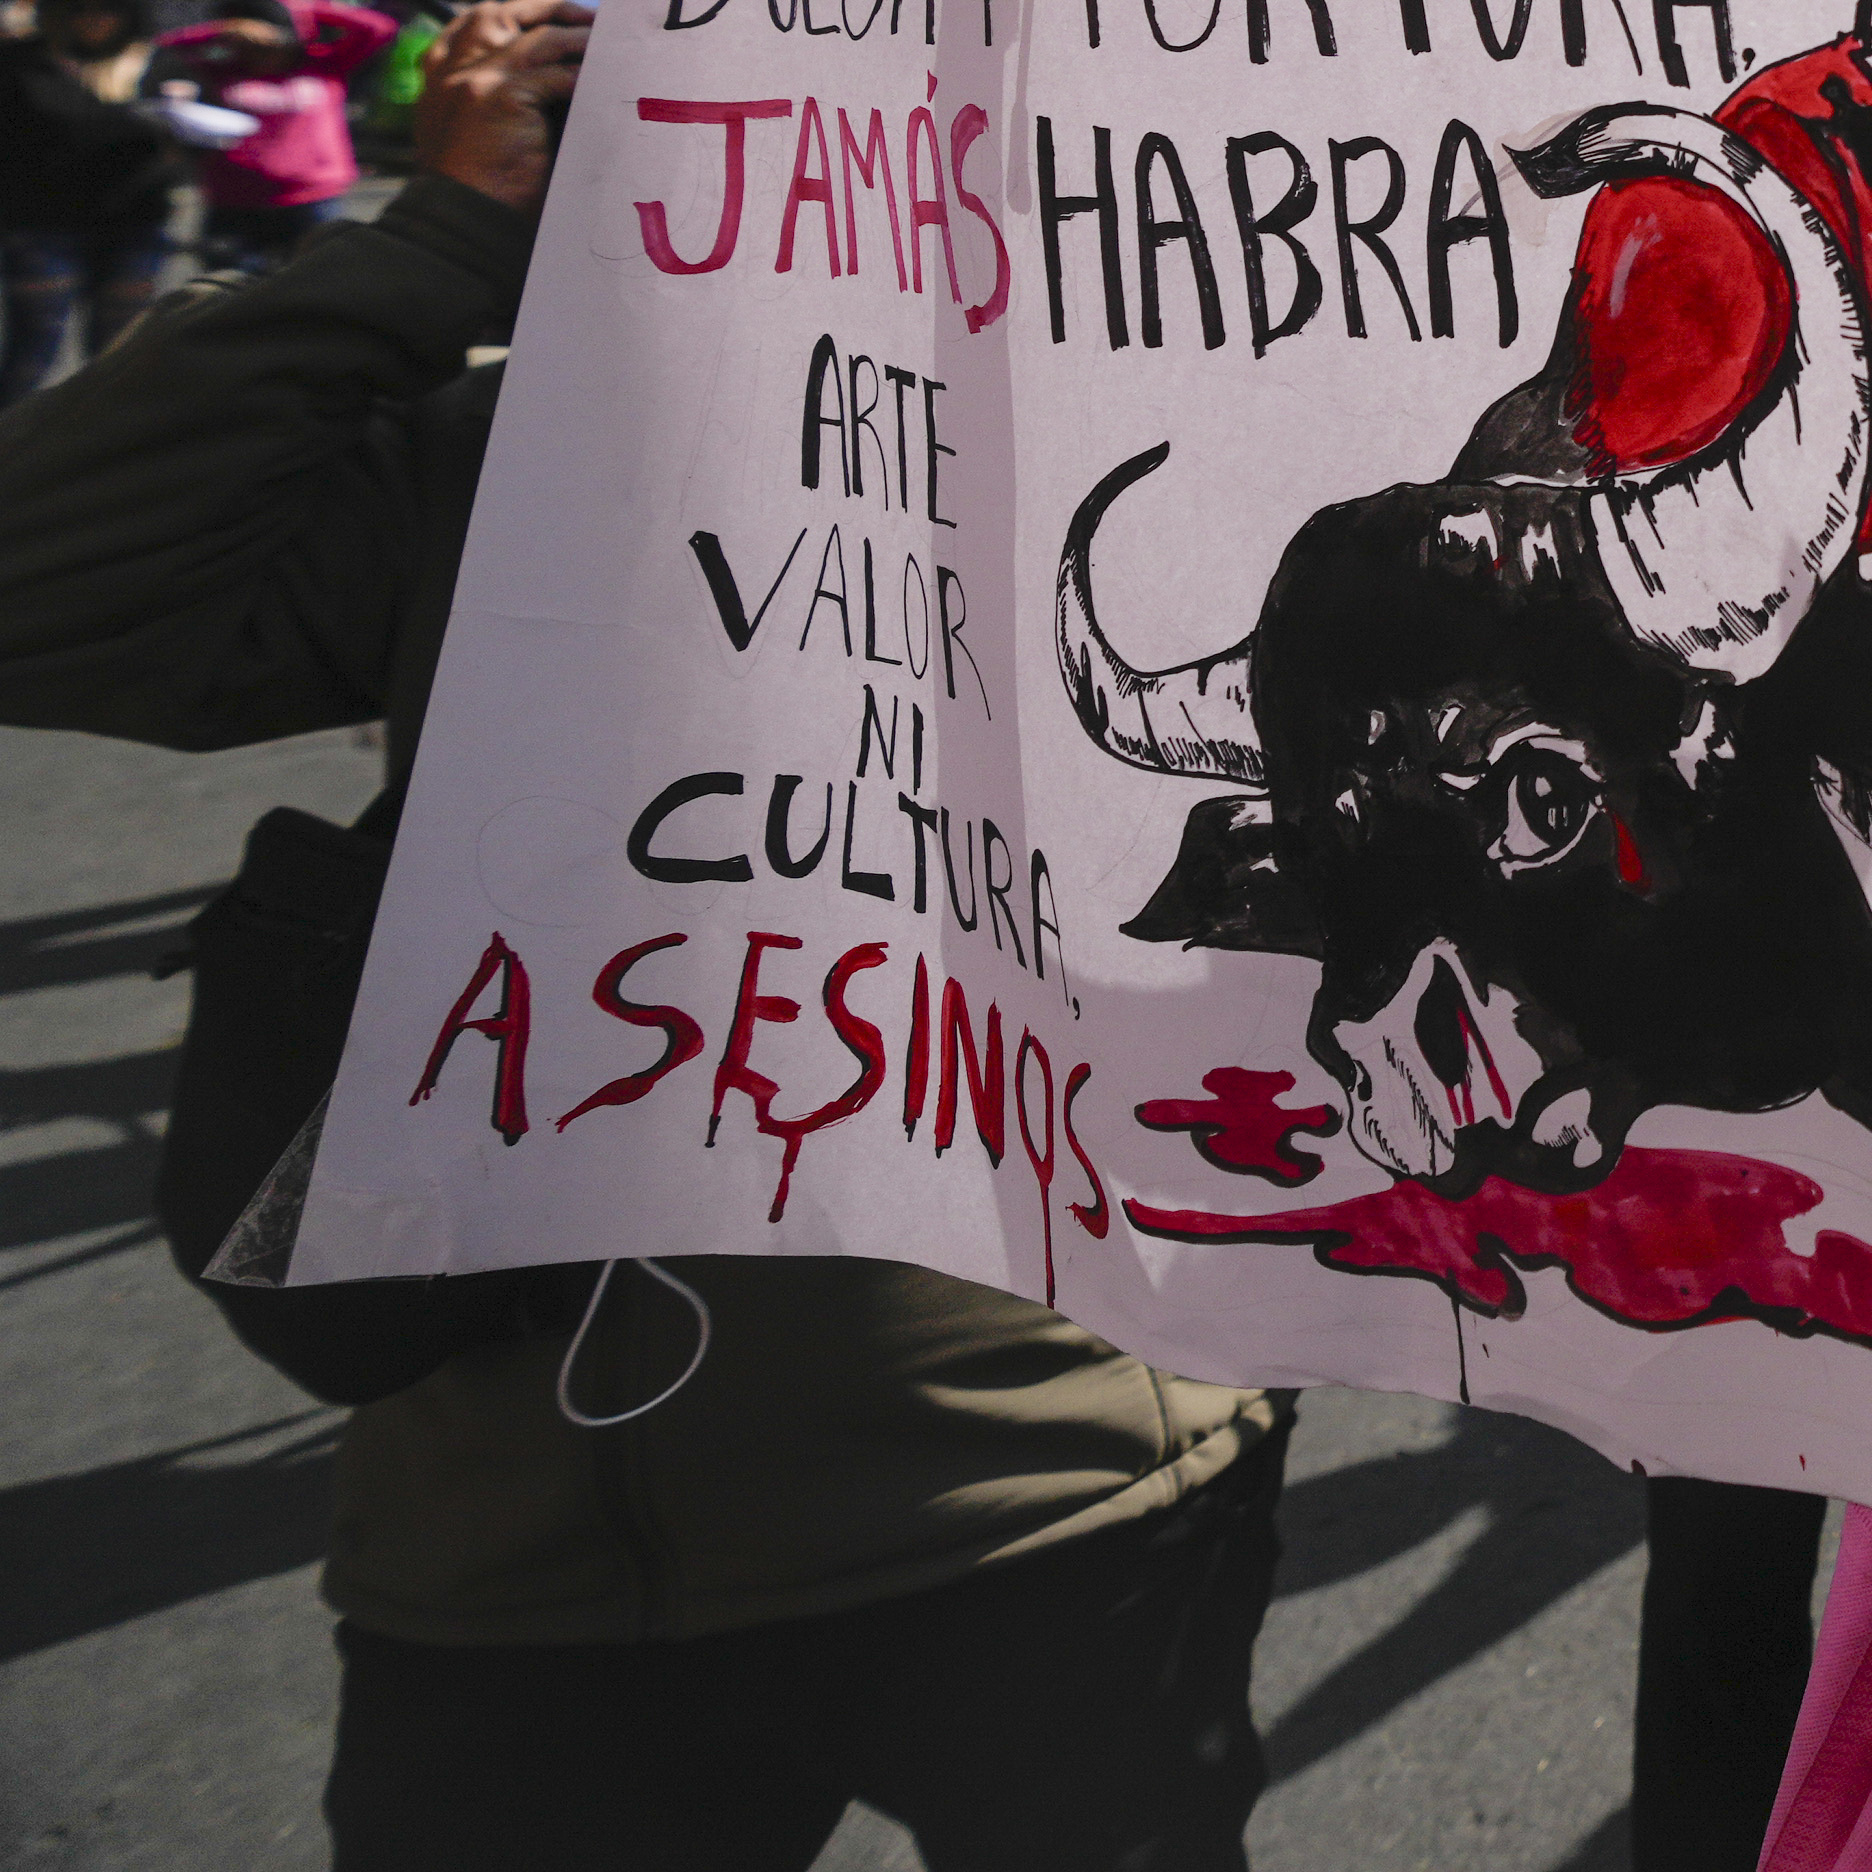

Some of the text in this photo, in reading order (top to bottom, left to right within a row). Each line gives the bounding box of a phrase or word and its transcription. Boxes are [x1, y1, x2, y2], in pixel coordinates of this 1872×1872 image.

[633, 70, 1521, 360] JAMÁS HABRA
[799, 331, 957, 530] ARTE
[687, 522, 993, 721] VALOR
[855, 682, 926, 796] NI
[626, 769, 1082, 1020] CULTURA,
[406, 928, 1111, 1309] ASESINOS
